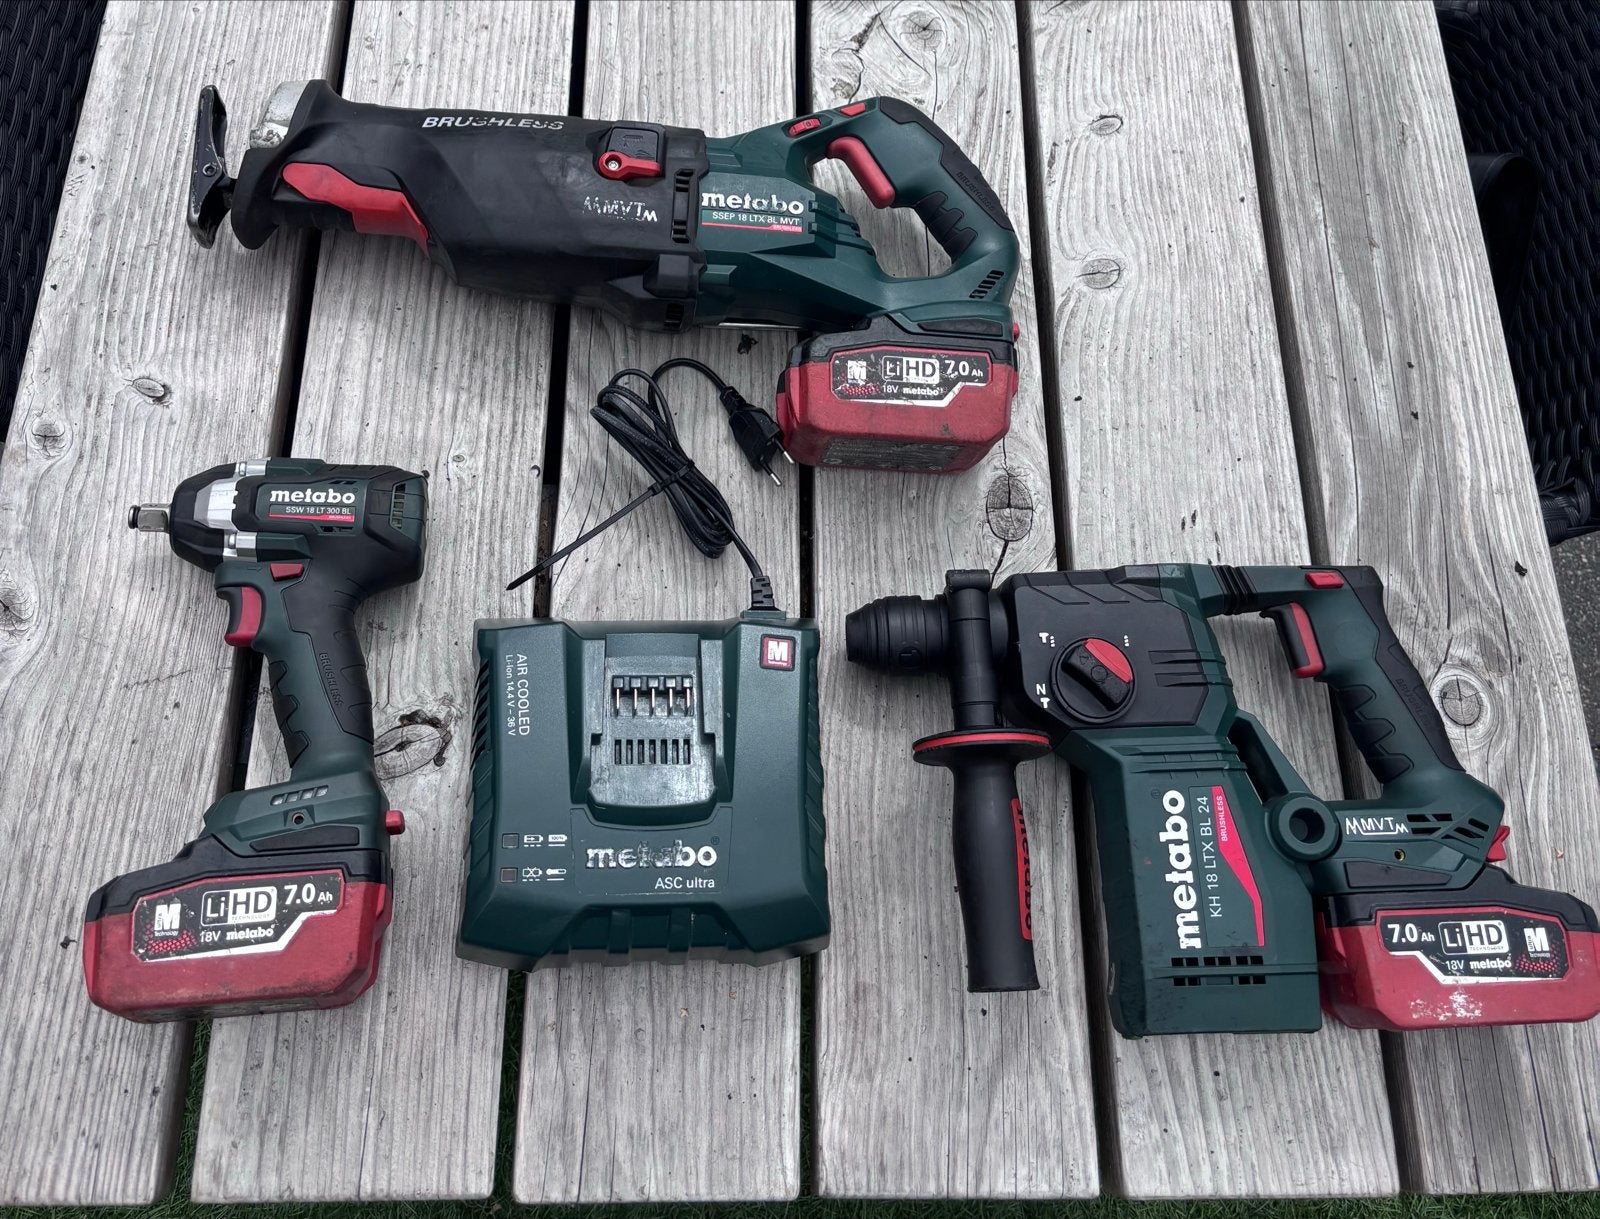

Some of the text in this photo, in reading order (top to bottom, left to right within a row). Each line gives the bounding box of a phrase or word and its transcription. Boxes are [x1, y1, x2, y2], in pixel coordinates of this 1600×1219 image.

[422, 116, 565, 130] BRUSHLESS
[701, 192, 804, 215] metabo
[712, 211, 800, 225] SSEP 18 LTX BL MVT
[886, 360, 936, 377] LiHD
[944, 359, 970, 377] 7.0
[883, 385, 899, 394] 18V
[270, 488, 356, 504] metabo
[286, 506, 305, 514] SSW
[505, 655, 514, 679] Li-Ion
[319, 652, 344, 706] BRUSHLESS
[517, 654, 530, 735] AIR COOLED
[1036, 683, 1046, 695] N
[507, 716, 516, 728] 36
[1217, 795, 1228, 842] BRUSHLESS
[586, 839, 717, 869] metabo
[1197, 796, 1223, 918] KH 18 LTX BL 24
[1159, 789, 1202, 949] metabo
[655, 877, 715, 889] ASC ultra
[206, 890, 272, 917] LiHD
[284, 883, 333, 905] 7.0 Ah
[200, 926, 274, 943] 18V metabo
[1388, 923, 1436, 943] 7.0 Ah
[1444, 924, 1503, 947] LiHD
[1446, 957, 1512, 970] 18V metabo
